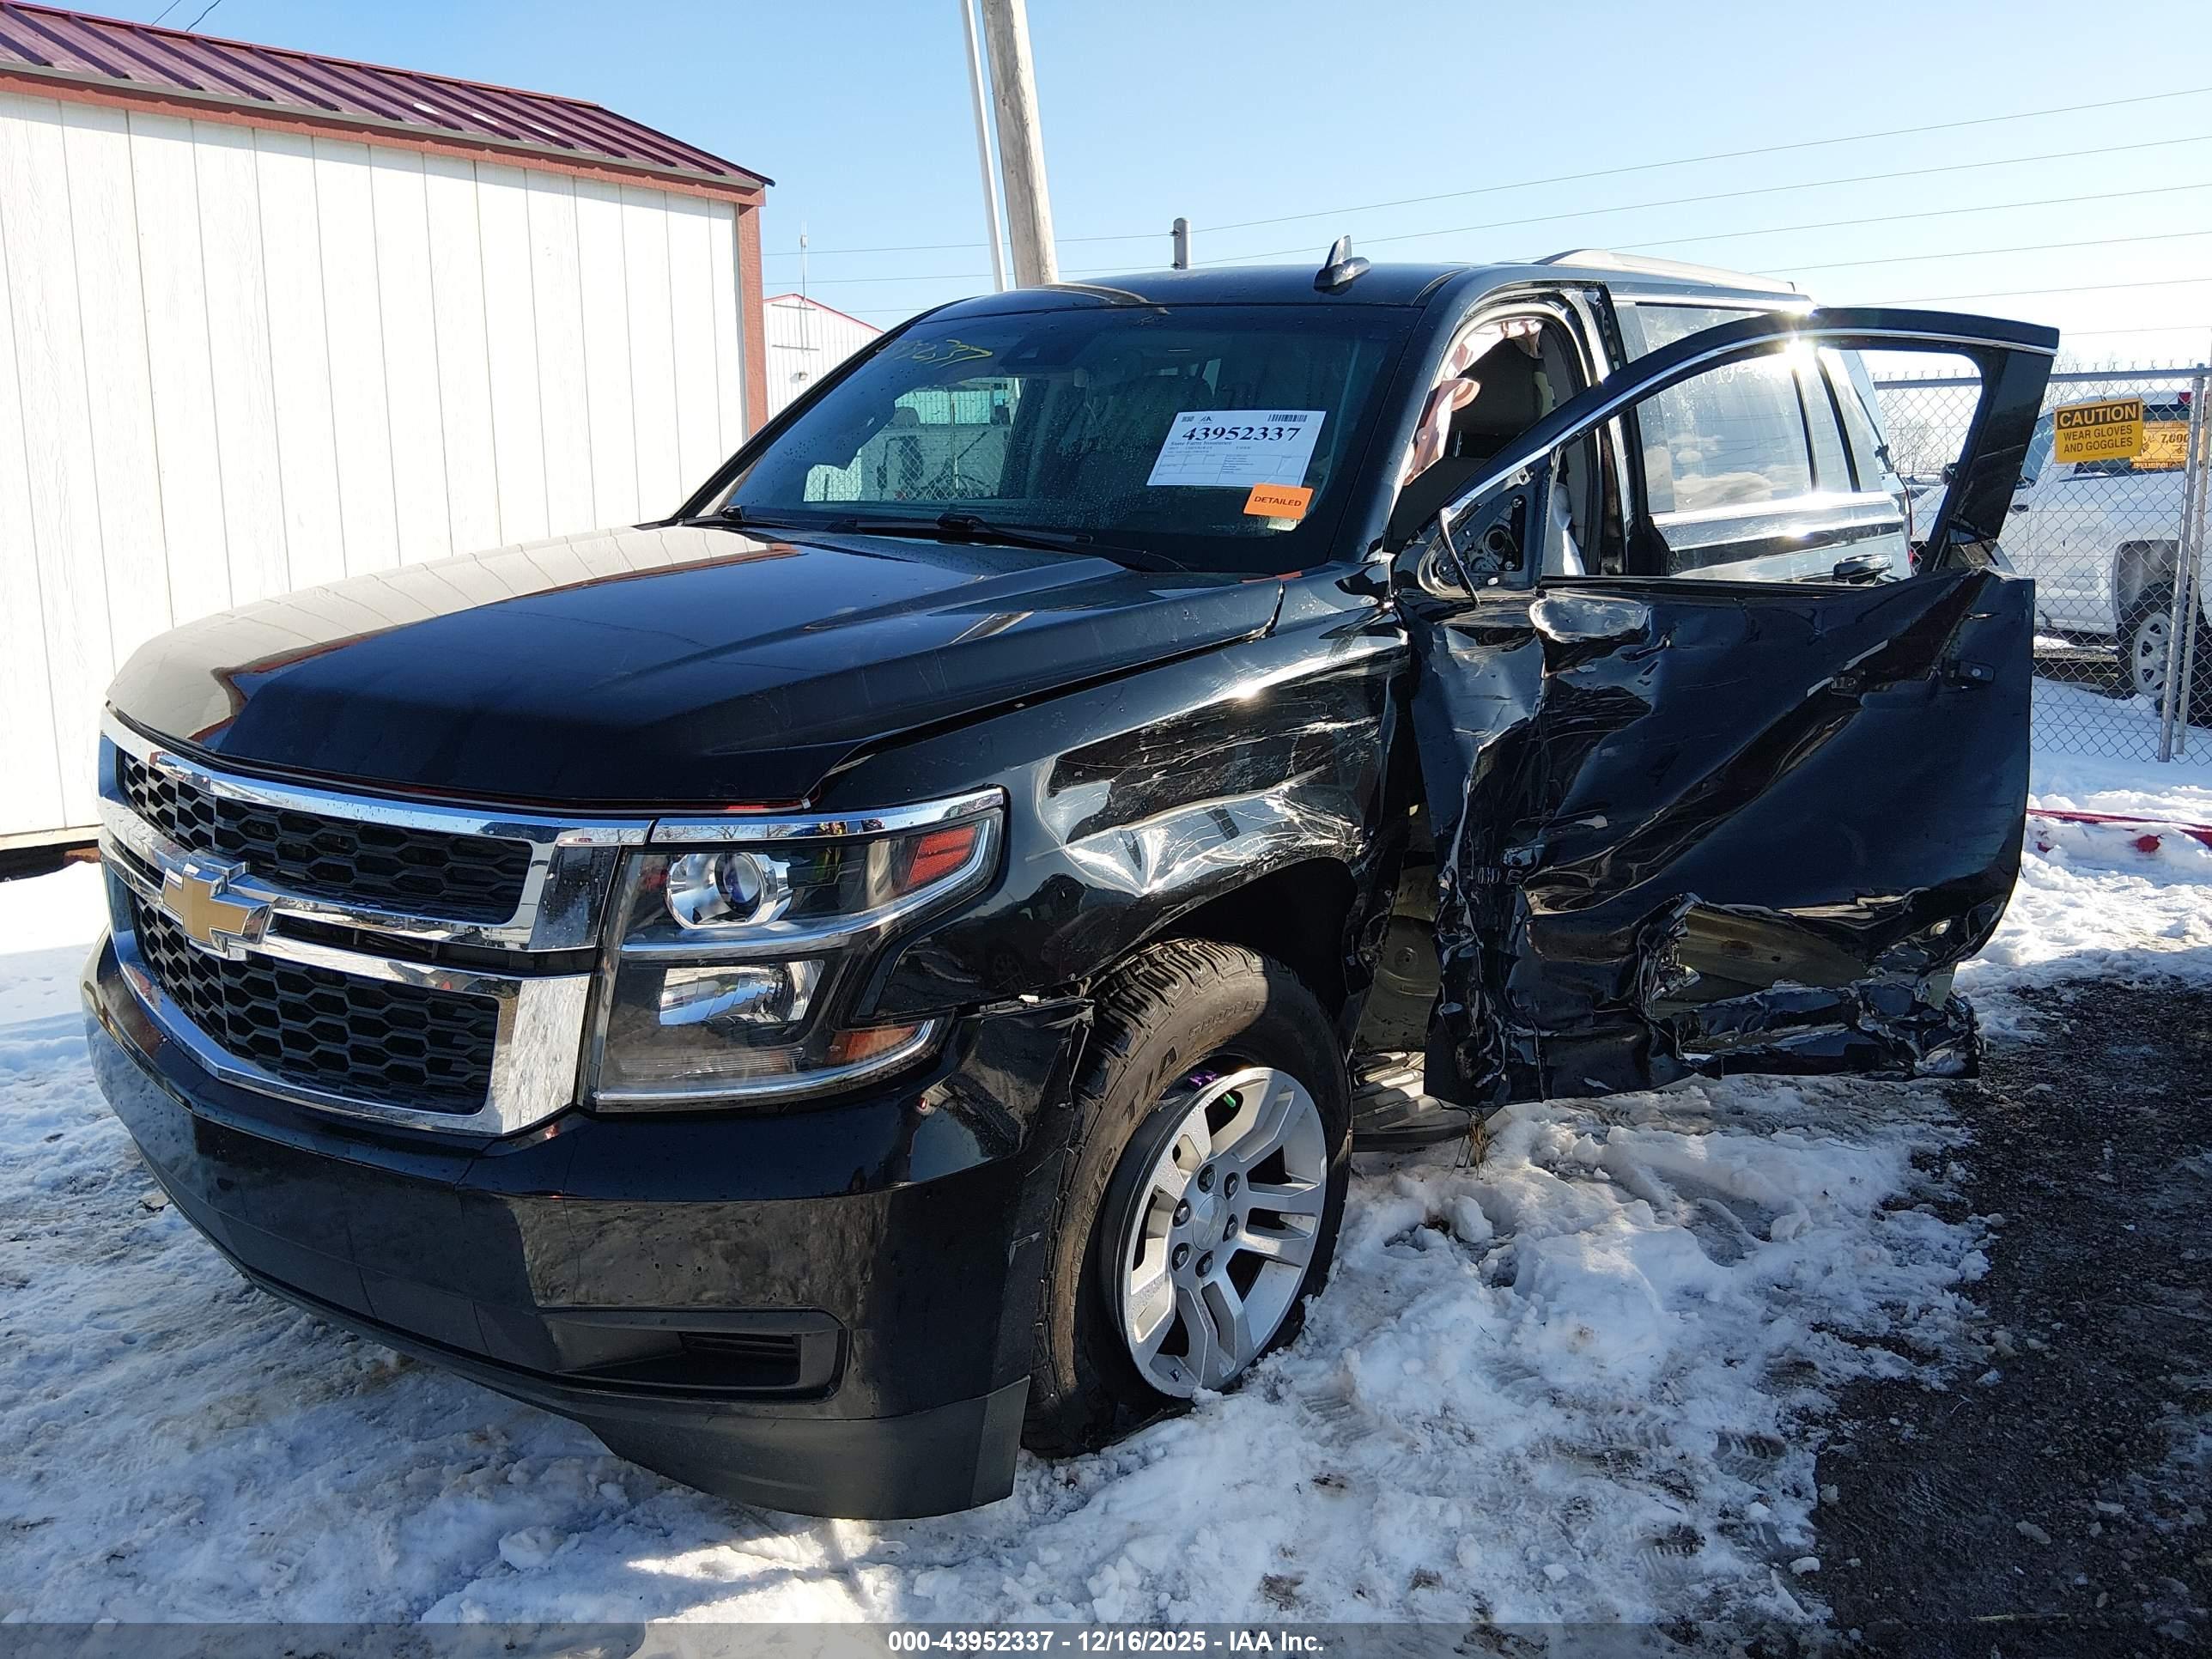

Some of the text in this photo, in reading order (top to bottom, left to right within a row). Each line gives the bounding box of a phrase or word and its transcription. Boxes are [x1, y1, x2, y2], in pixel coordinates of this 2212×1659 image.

[2059, 404, 2136, 428] CAUTION
[1182, 426, 1302, 441] 43952337
[2063, 430, 2091, 441] WEAR
[2094, 424, 2132, 439] GLOVES
[2063, 442, 2083, 453] AND
[2086, 437, 2133, 451] GOGGLES
[1254, 495, 1302, 507] DETAILED
